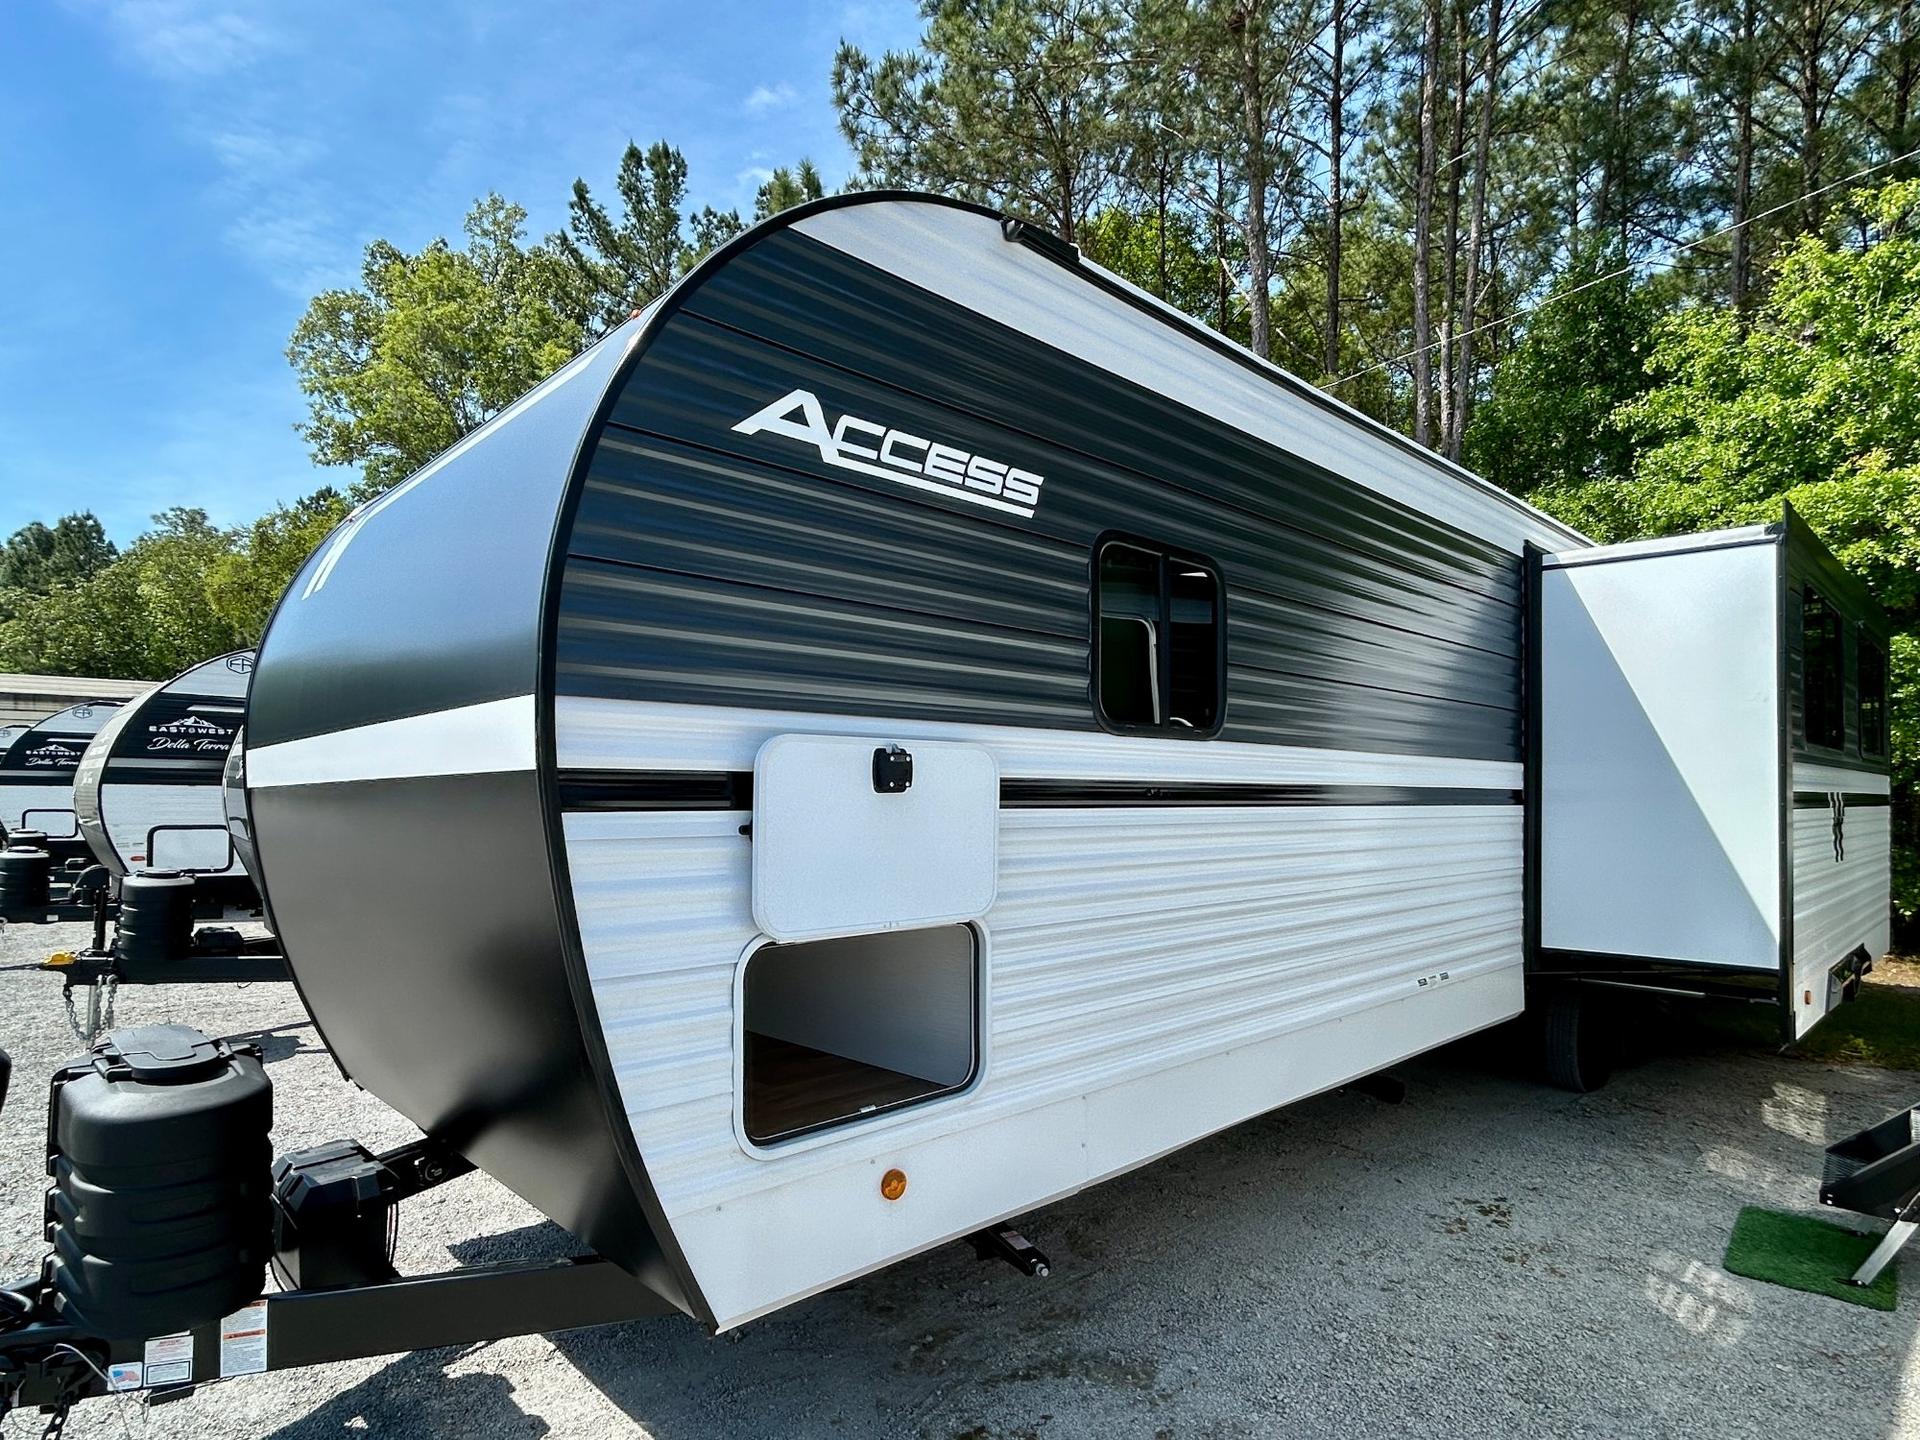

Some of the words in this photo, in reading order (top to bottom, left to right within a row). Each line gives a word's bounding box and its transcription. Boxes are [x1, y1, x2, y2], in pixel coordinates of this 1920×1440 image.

[731, 389, 1044, 518] ACCESS
[147, 737, 190, 750] Della
[193, 738, 230, 752] Terra
